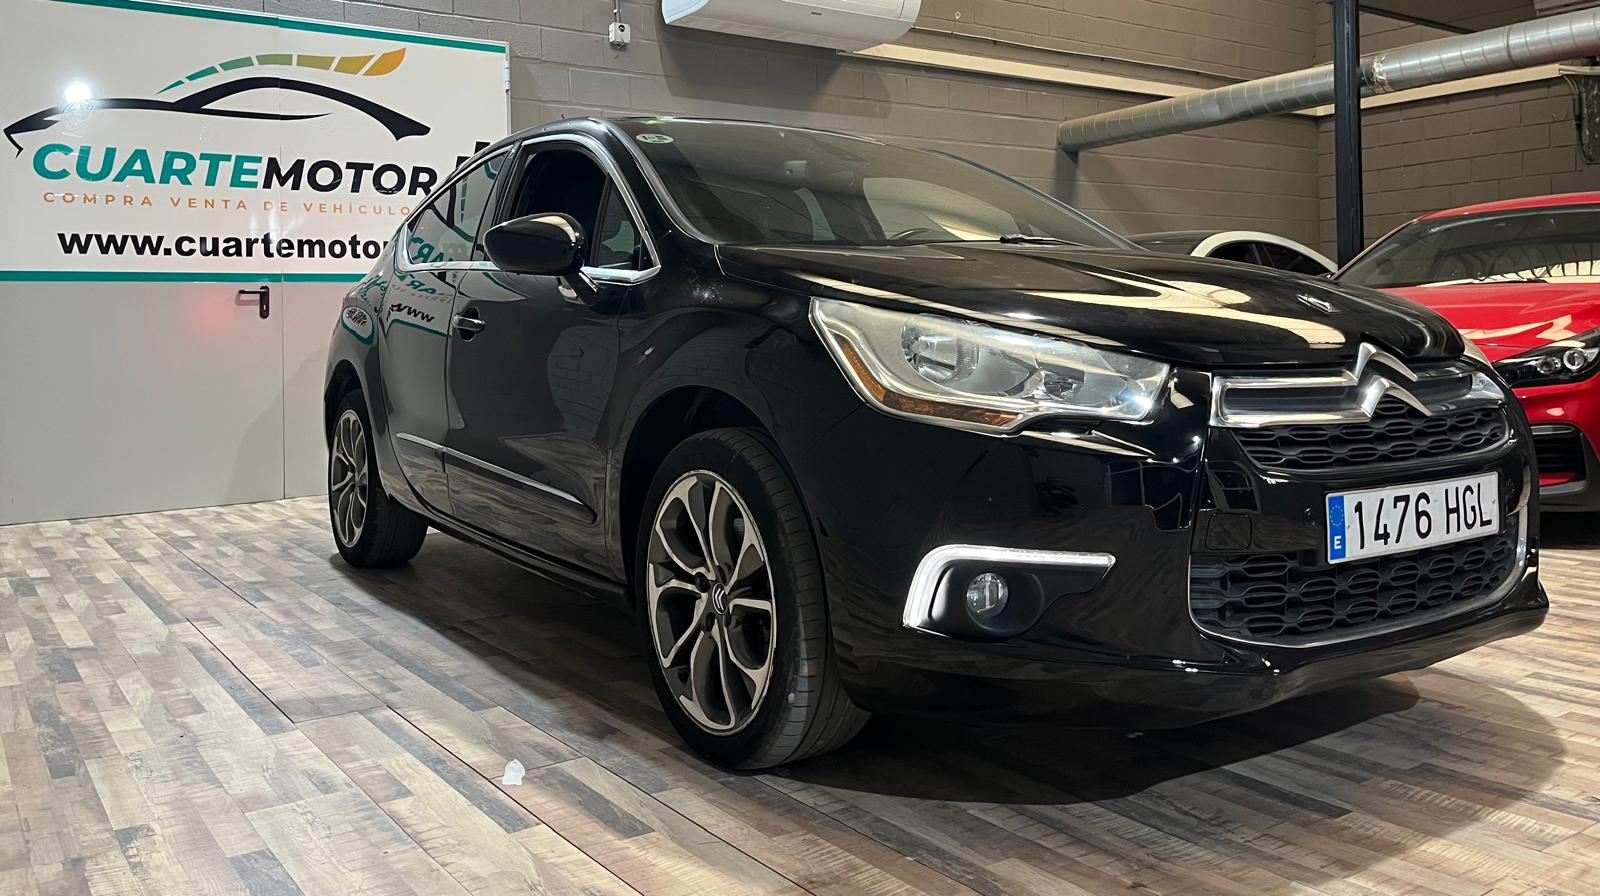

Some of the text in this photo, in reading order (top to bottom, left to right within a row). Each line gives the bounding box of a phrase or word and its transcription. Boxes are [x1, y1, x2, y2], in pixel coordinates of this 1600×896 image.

[33, 143, 438, 197] CUARTEMOTOR
[43, 192, 152, 207] COMPRA
[170, 197, 247, 210] VENTA
[263, 201, 288, 212] DE
[1354, 483, 1493, 550] 1476 HGL
[1333, 535, 1342, 549] E
